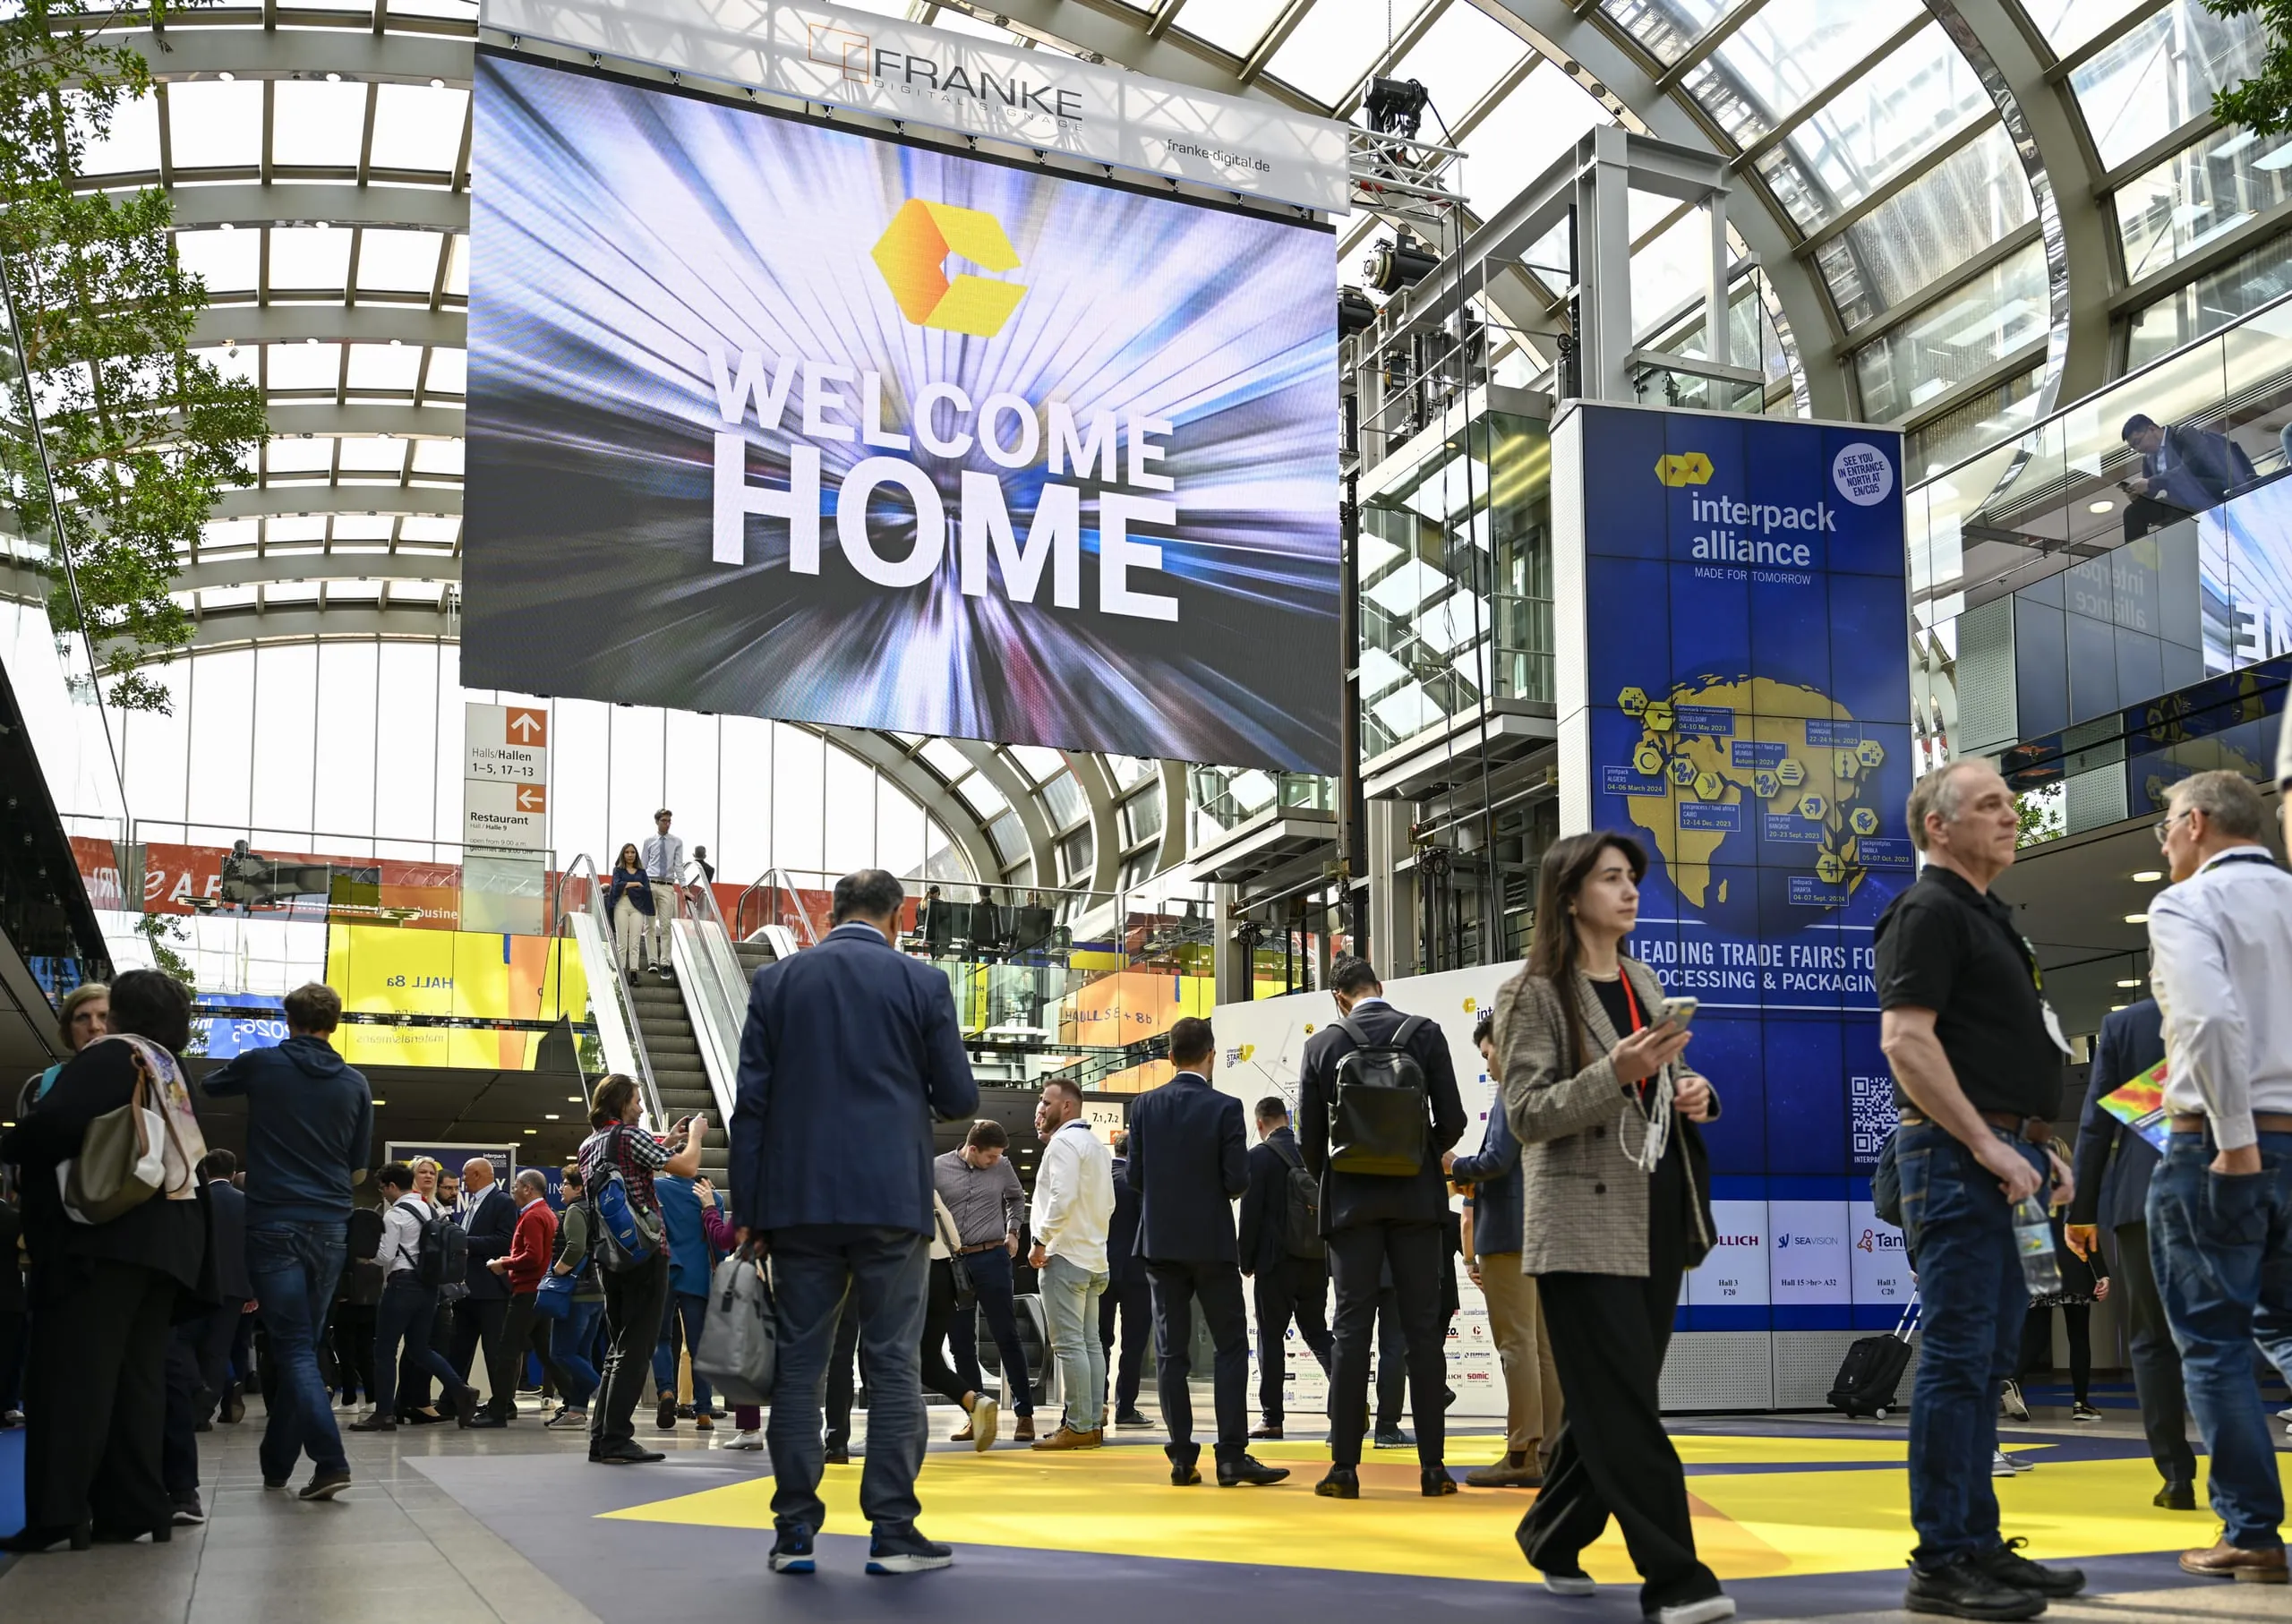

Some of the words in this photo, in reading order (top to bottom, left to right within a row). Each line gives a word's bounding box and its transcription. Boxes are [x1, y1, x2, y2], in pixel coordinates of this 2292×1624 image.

[875, 47, 1082, 122] FRANKE
[874, 79, 964, 107] DIGITAL
[979, 102, 1082, 132] SIGNAGE
[1167, 138, 1270, 173] franke-digital.de
[706, 345, 1175, 492] WELCOME
[1843, 455, 1858, 466] SEE
[1858, 452, 1874, 464] YOU
[1837, 467, 1847, 479] IN
[1847, 461, 1885, 477] ENTRANCE
[1846, 475, 1871, 488] NORTH
[1872, 472, 1881, 483] AT
[1692, 491, 1836, 534] interpack
[713, 432, 1178, 622] HOME
[1691, 530, 1810, 567] alliance
[1695, 567, 1724, 580] MADE
[1727, 569, 1748, 581] FOR
[1752, 571, 1811, 585] TOMORROW
[472, 748, 532, 762] Halls/Hallen
[470, 811, 529, 825] Restaurant
[1789, 832, 1803, 840] Sept.
[1629, 940, 1714, 965] LEADING
[1720, 943, 1783, 968] TRADE
[1791, 944, 1846, 970] FAIRS
[1853, 946, 1875, 970] FO
[1657, 969, 1755, 989] OCESSING
[1763, 972, 1776, 990] &
[1783, 973, 1877, 993] PACKAGIN
[1477, 1007, 1493, 1021] int
[1227, 1053, 1243, 1062] START
[1715, 1235, 1758, 1246] LLICH
[1794, 1236, 1838, 1245] SEAVISION
[1876, 1233, 1904, 1247] Tan
[1781, 1278, 1795, 1286] Hall
[1877, 1278, 1891, 1286] Hall
